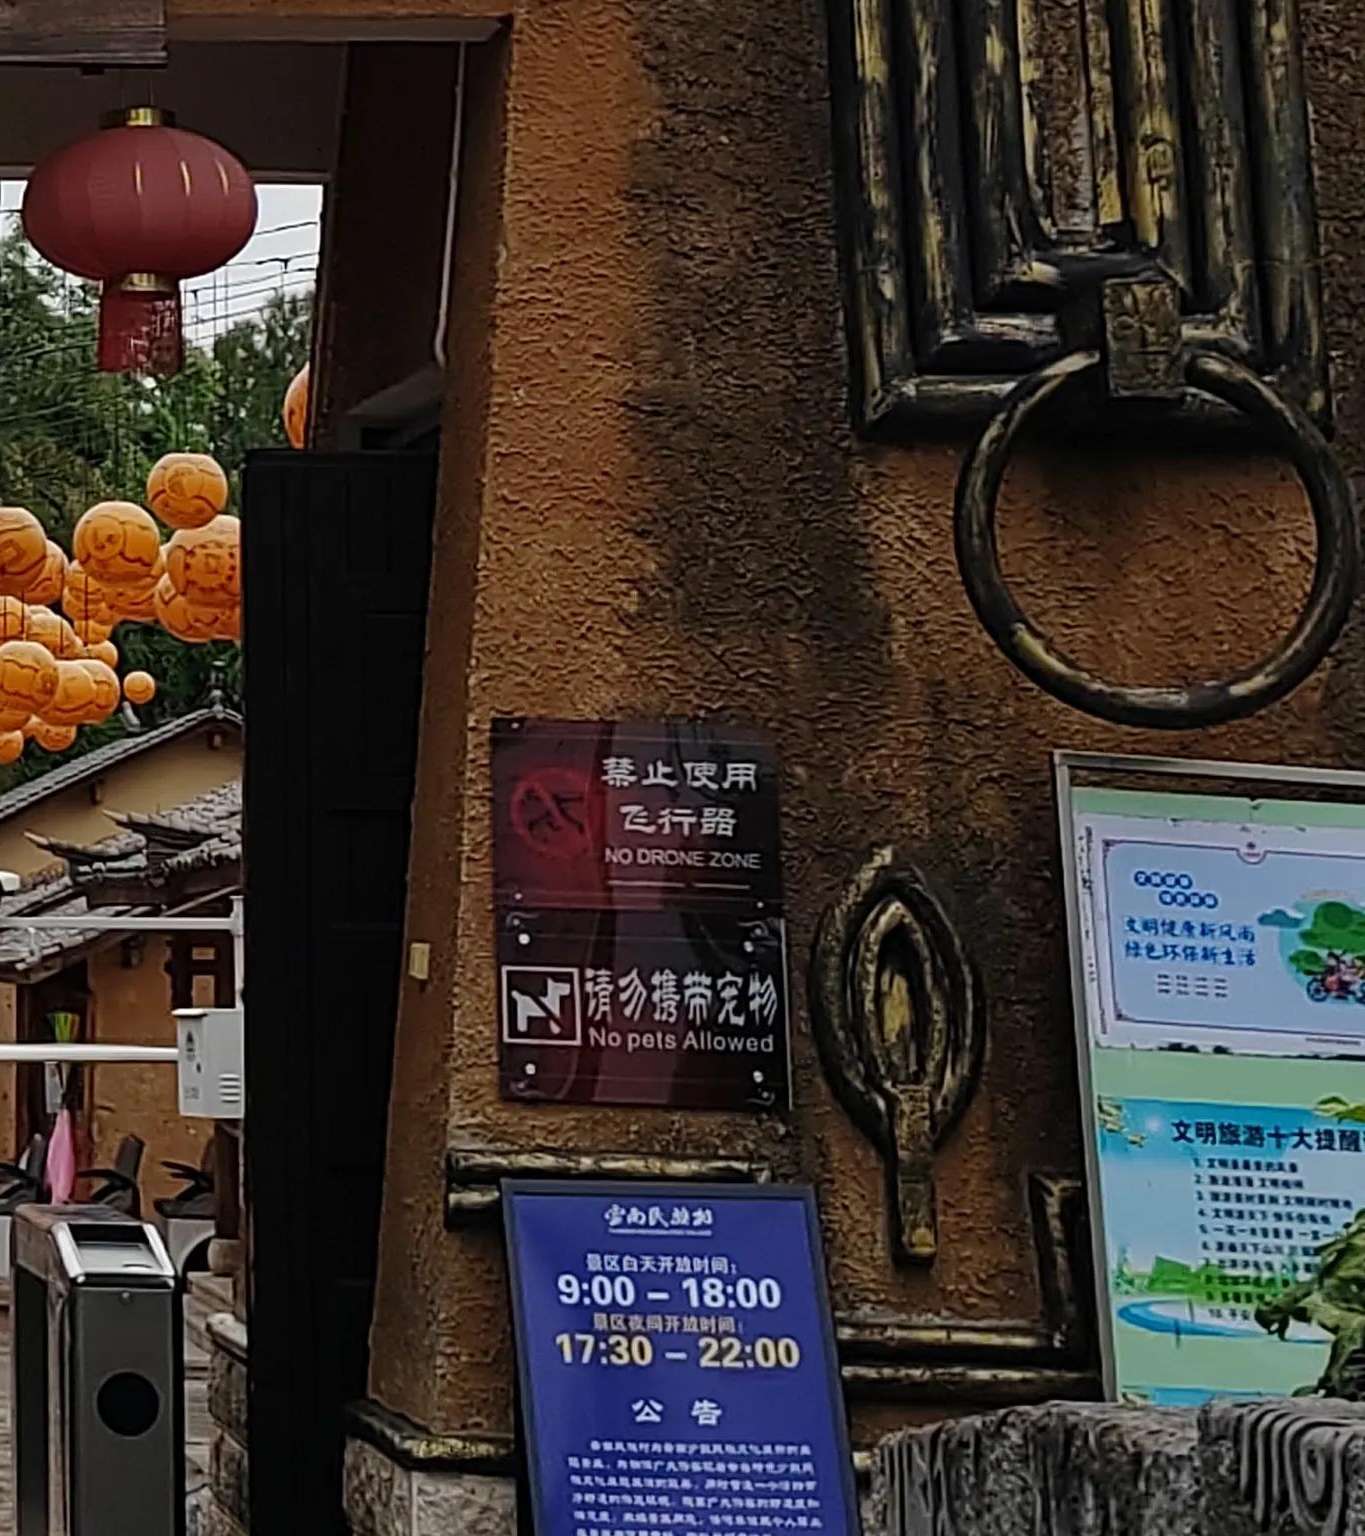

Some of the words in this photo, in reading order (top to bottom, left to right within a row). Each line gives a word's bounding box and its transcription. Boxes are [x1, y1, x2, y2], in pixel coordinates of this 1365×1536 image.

[600, 756, 758, 792] 禁止使用
[619, 804, 737, 838] 飞行器
[604, 847, 633, 865] NO
[636, 848, 705, 868] DRONE
[708, 851, 762, 870] ZONE
[1124, 939, 1256, 967] 绿色环保新生活
[585, 967, 778, 1026] 请勿携带宠物
[589, 1027, 622, 1047] No
[627, 1030, 677, 1054] pets
[683, 1029, 775, 1052] Allowed
[1172, 1120, 1365, 1152] 文明旅游十大提醒
[557, 1275, 635, 1307] 9:00
[682, 1278, 781, 1309] 18:00
[555, 1334, 653, 1366] 17:30
[699, 1338, 800, 1370] 22:00
[632, 1399, 723, 1426] 公告
